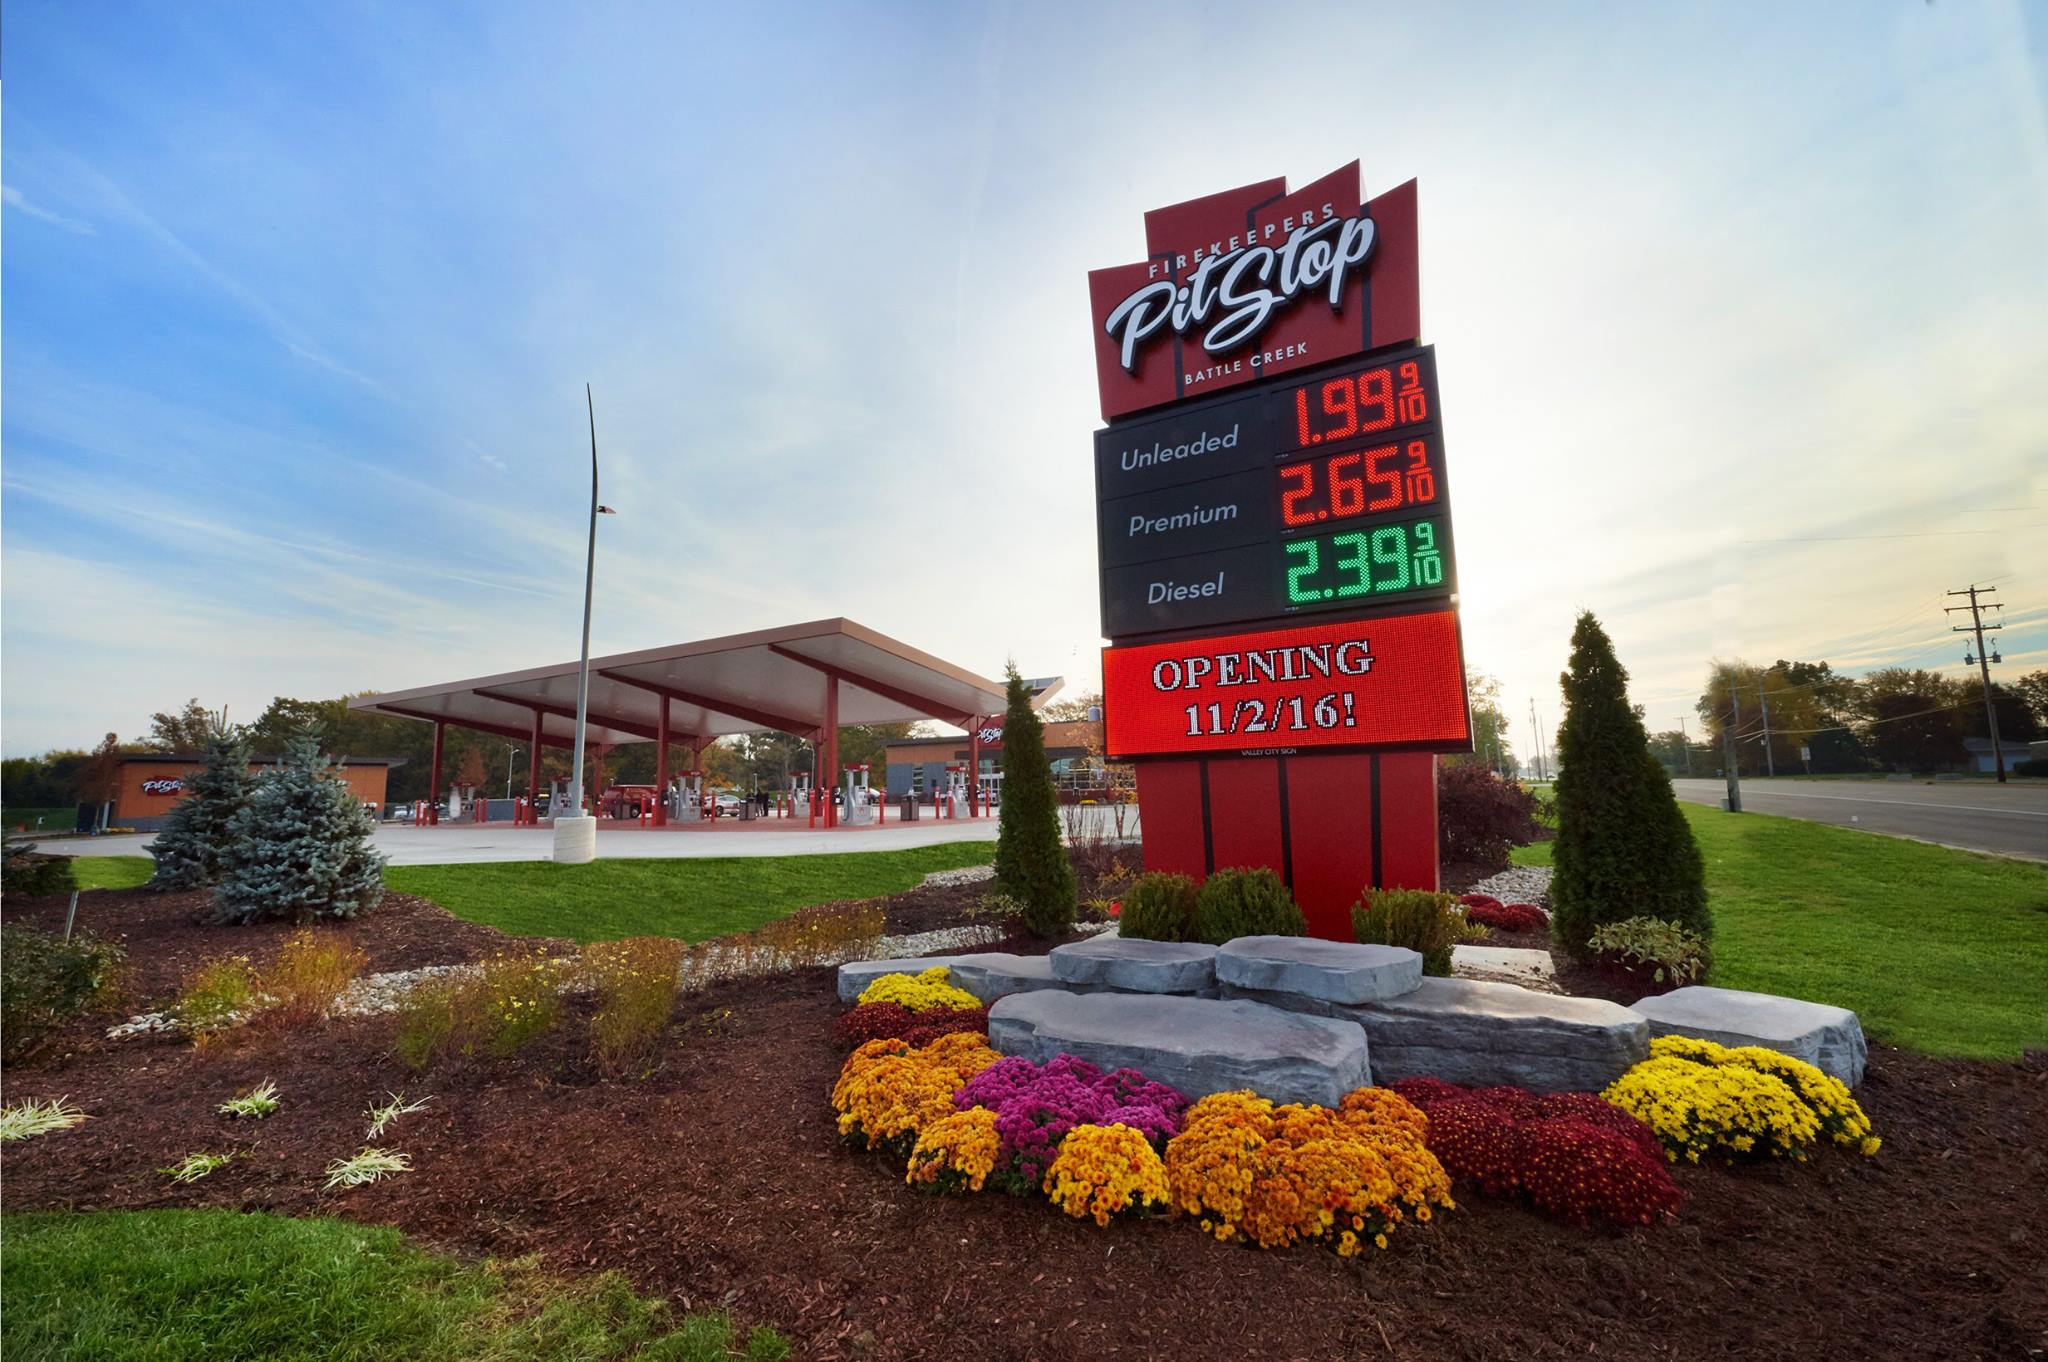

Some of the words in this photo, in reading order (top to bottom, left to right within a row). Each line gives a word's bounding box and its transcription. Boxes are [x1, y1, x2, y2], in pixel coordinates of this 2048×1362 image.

[1148, 202, 1334, 279] FIREKEEPERS
[1185, 359, 1241, 386] BATTLE
[1249, 341, 1308, 368] CREEK
[1296, 368, 1396, 447] 1.99
[1121, 424, 1240, 471] Unleaded
[1280, 446, 1402, 525] 2.65
[1129, 503, 1238, 537] Premium
[1148, 571, 1225, 605] Diesel
[1285, 526, 1410, 602] 2.39
[1152, 640, 1374, 691] OPENING
[1186, 692, 1357, 736] 11/2/16!
